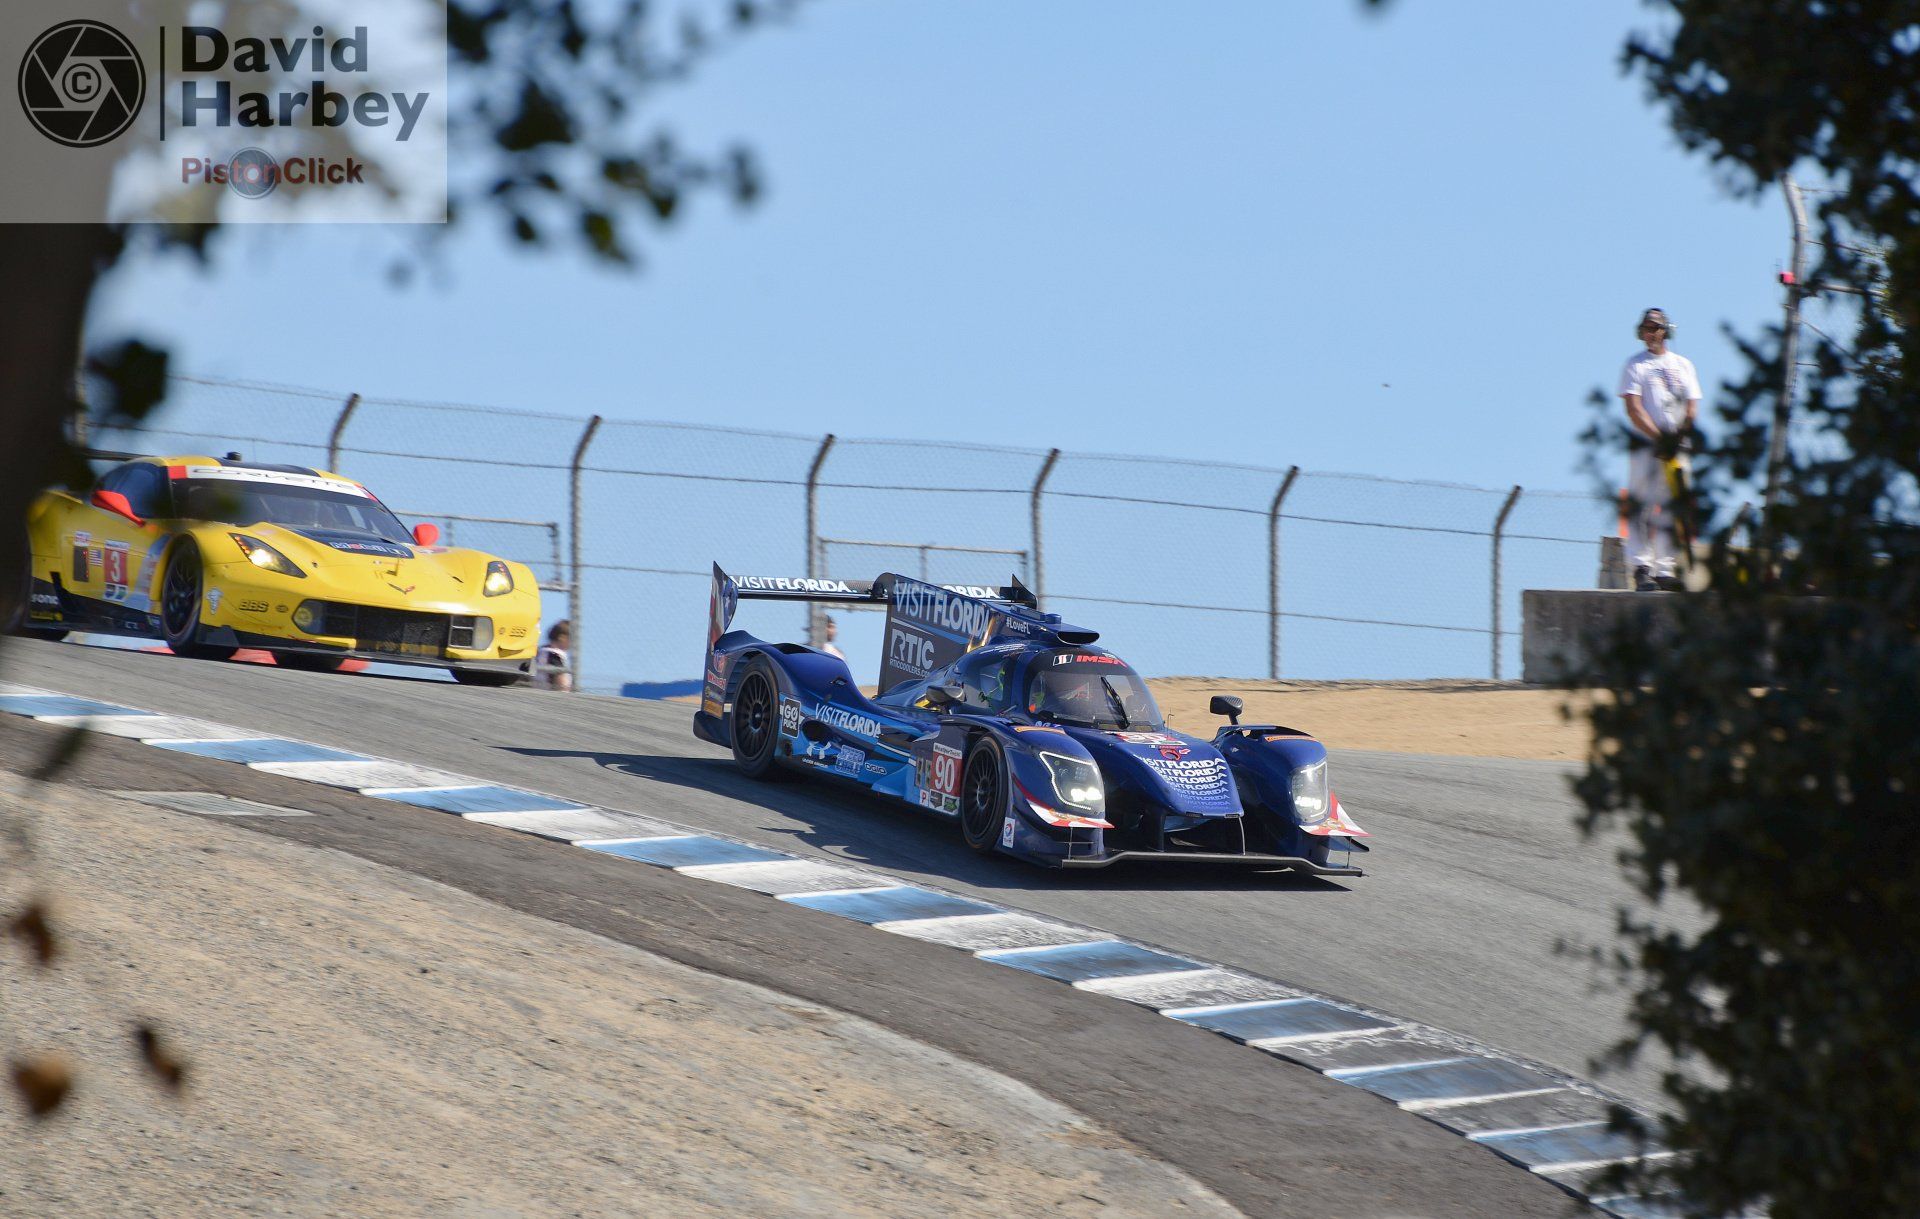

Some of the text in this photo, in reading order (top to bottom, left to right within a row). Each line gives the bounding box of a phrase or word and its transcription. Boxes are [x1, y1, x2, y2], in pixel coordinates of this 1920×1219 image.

[110, 551, 120, 582] 3
[894, 579, 991, 640] VISITFLORIDA
[1006, 617, 1031, 635] #LoveFL
[890, 629, 935, 670] RTIC
[815, 702, 882, 739] VISITFLORIDA
[935, 755, 955, 793] 90
